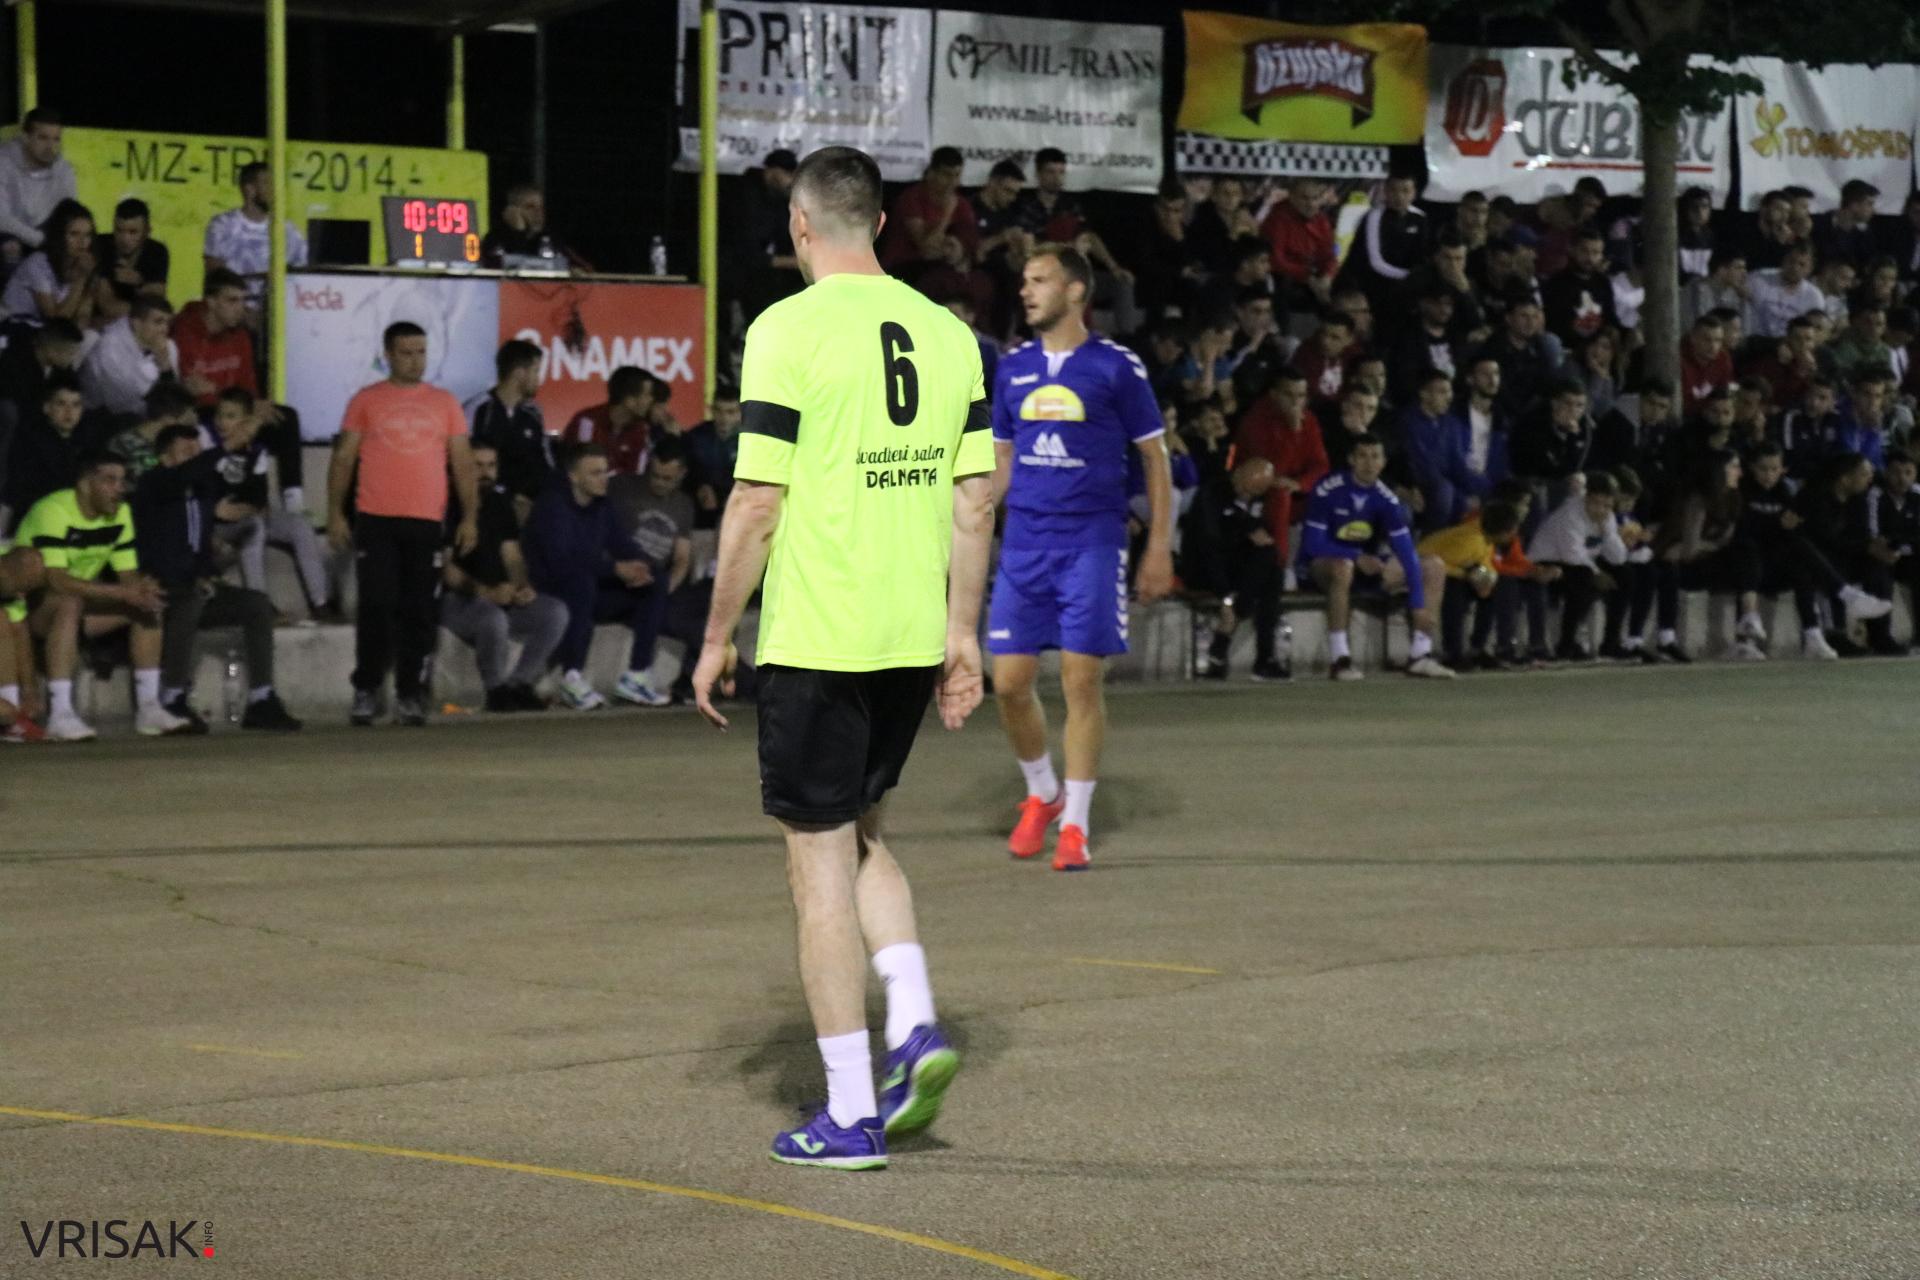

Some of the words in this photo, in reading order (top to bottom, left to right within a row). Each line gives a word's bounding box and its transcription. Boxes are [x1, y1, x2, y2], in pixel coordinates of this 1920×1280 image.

[719, 8, 897, 81] PRINT
[1003, 43, 1156, 79] MIL-TRANS
[403, 201, 469, 234] 10:09
[415, 233, 424, 258] 1
[465, 232, 481, 263] 0
[294, 284, 345, 311] leda
[880, 320, 919, 427] 6
